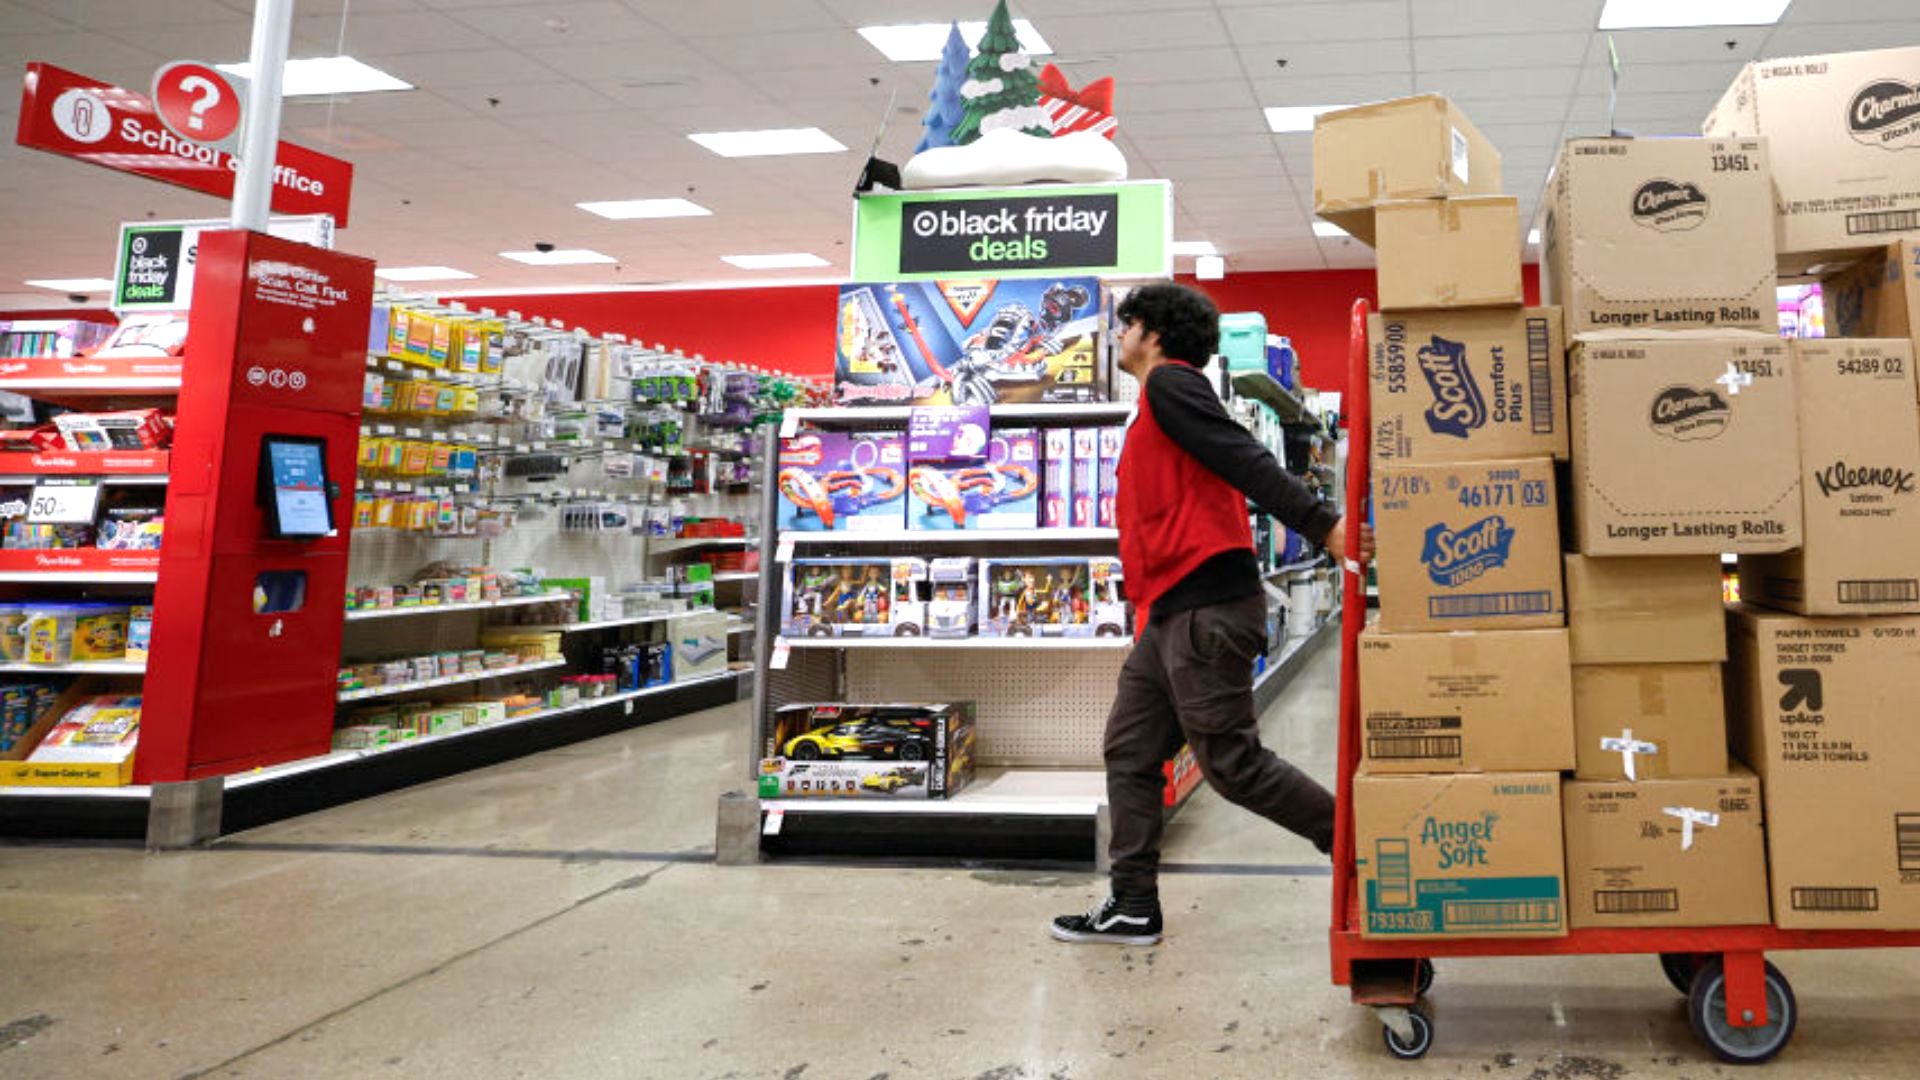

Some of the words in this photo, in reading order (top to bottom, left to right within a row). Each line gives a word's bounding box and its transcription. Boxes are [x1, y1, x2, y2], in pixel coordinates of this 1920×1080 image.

[1857, 84, 1920, 124] Charmi
[120, 117, 219, 165] School
[272, 164, 325, 196] ffice
[1711, 155, 1750, 171] 13451
[940, 208, 1018, 237] black
[1024, 205, 1107, 236] friday
[968, 235, 1048, 262] deals
[129, 254, 168, 270] black
[127, 270, 169, 286] friday
[125, 283, 164, 299] deals
[1590, 310, 1649, 325] Longer
[1653, 308, 1716, 324] Lasting
[1720, 306, 1760, 320] Rolls
[1884, 357, 1904, 374] 02
[1418, 350, 1474, 426] Scott
[1490, 345, 1506, 423] Comfort
[1510, 382, 1523, 422] Plus
[1814, 460, 1916, 498] Kleenex
[1458, 484, 1515, 508] 46171
[1522, 482, 1547, 505] 03
[32, 497, 57, 516] 50
[1606, 523, 1668, 539] Longer
[1672, 521, 1738, 539] Lasting
[1742, 520, 1785, 535] Rolls
[1433, 516, 1501, 568] Scott
[1775, 629, 1812, 639] PAPER
[1814, 627, 1861, 639] TOWELS
[1779, 711, 1825, 726] up&up
[1802, 730, 1818, 740] CT
[1782, 752, 1819, 761] PAPER
[1823, 752, 1869, 761] TOWELS
[1420, 815, 1496, 845] Angel
[1438, 840, 1490, 869] Soft
